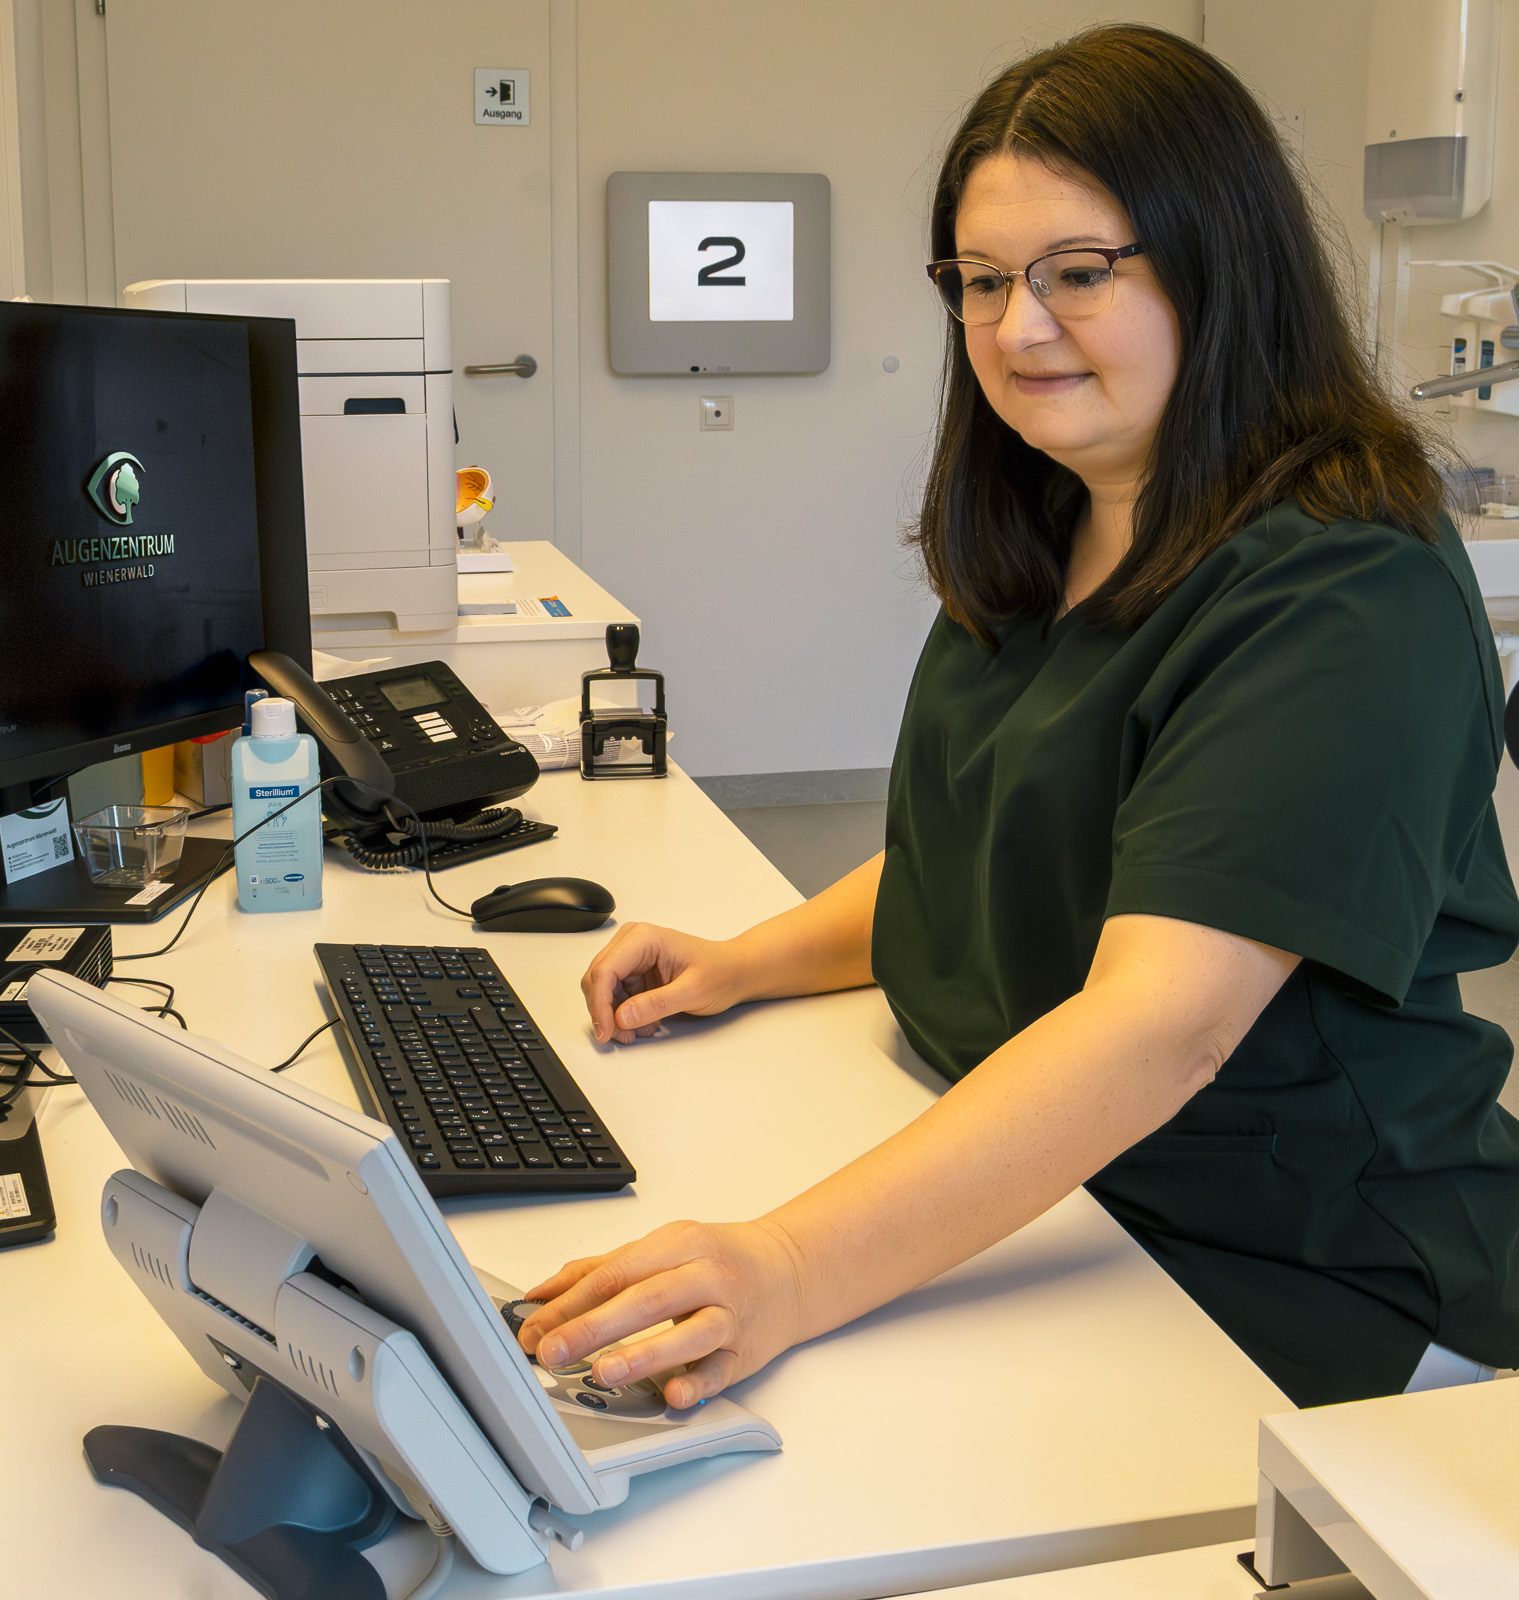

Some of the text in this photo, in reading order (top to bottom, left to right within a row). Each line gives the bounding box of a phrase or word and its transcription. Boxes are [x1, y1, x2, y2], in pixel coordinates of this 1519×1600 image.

[483, 108, 522, 120] Ausgang
[697, 236, 746, 286] 2
[51, 534, 175, 565] AUGENZENTRUM
[83, 564, 155, 586] WIENERWALD
